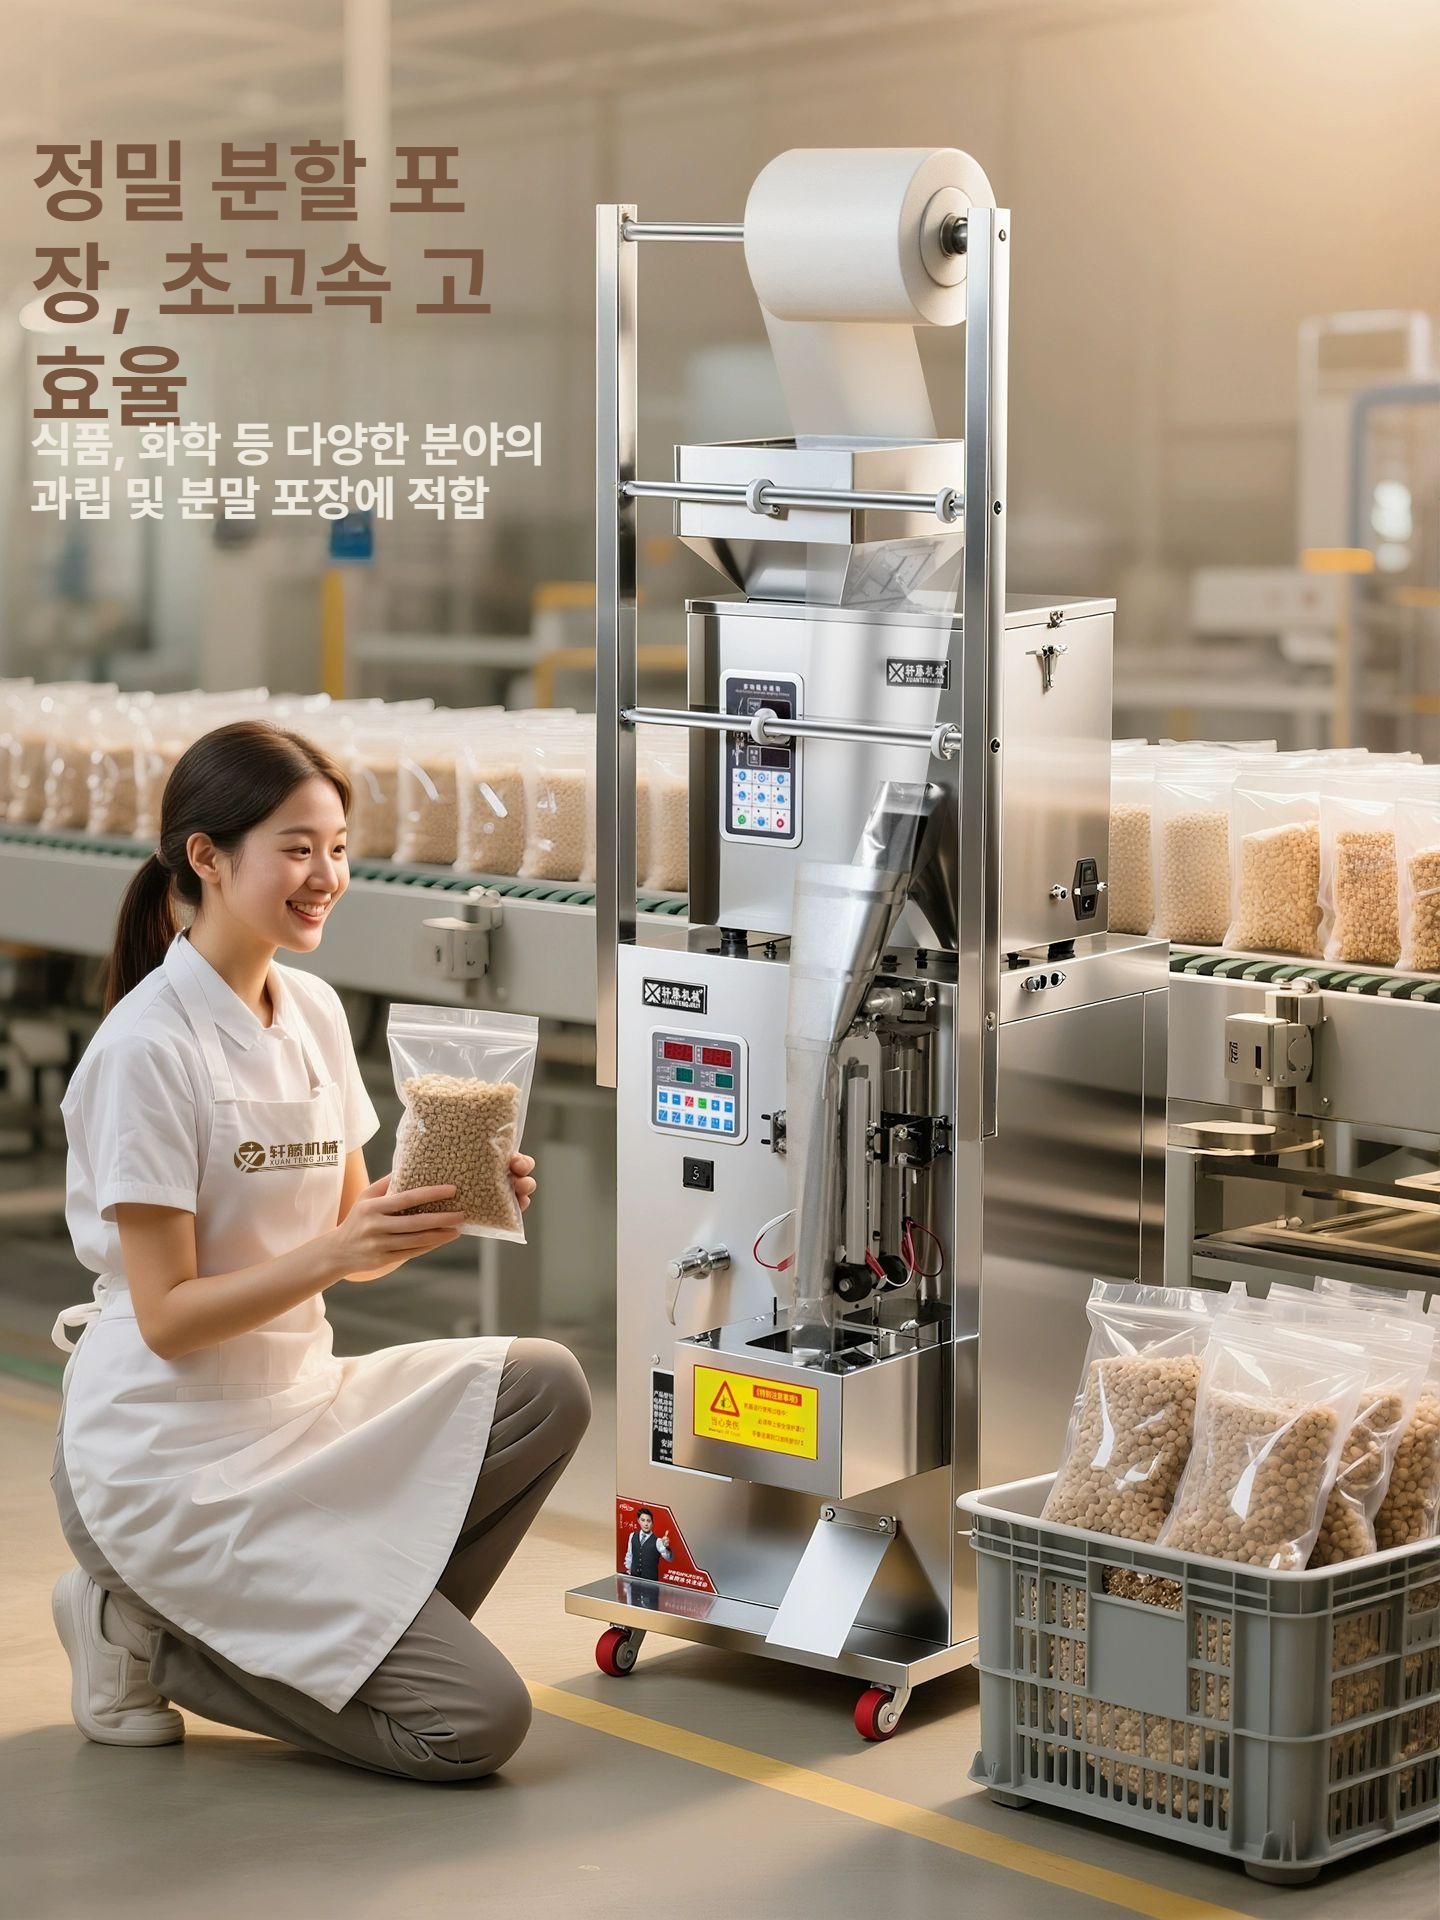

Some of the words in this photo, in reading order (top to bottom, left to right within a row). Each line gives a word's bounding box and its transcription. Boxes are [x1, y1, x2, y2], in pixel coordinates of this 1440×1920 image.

[269, 1140, 338, 1159] 轩藤机械
[270, 1158, 291, 1166] XUAN
